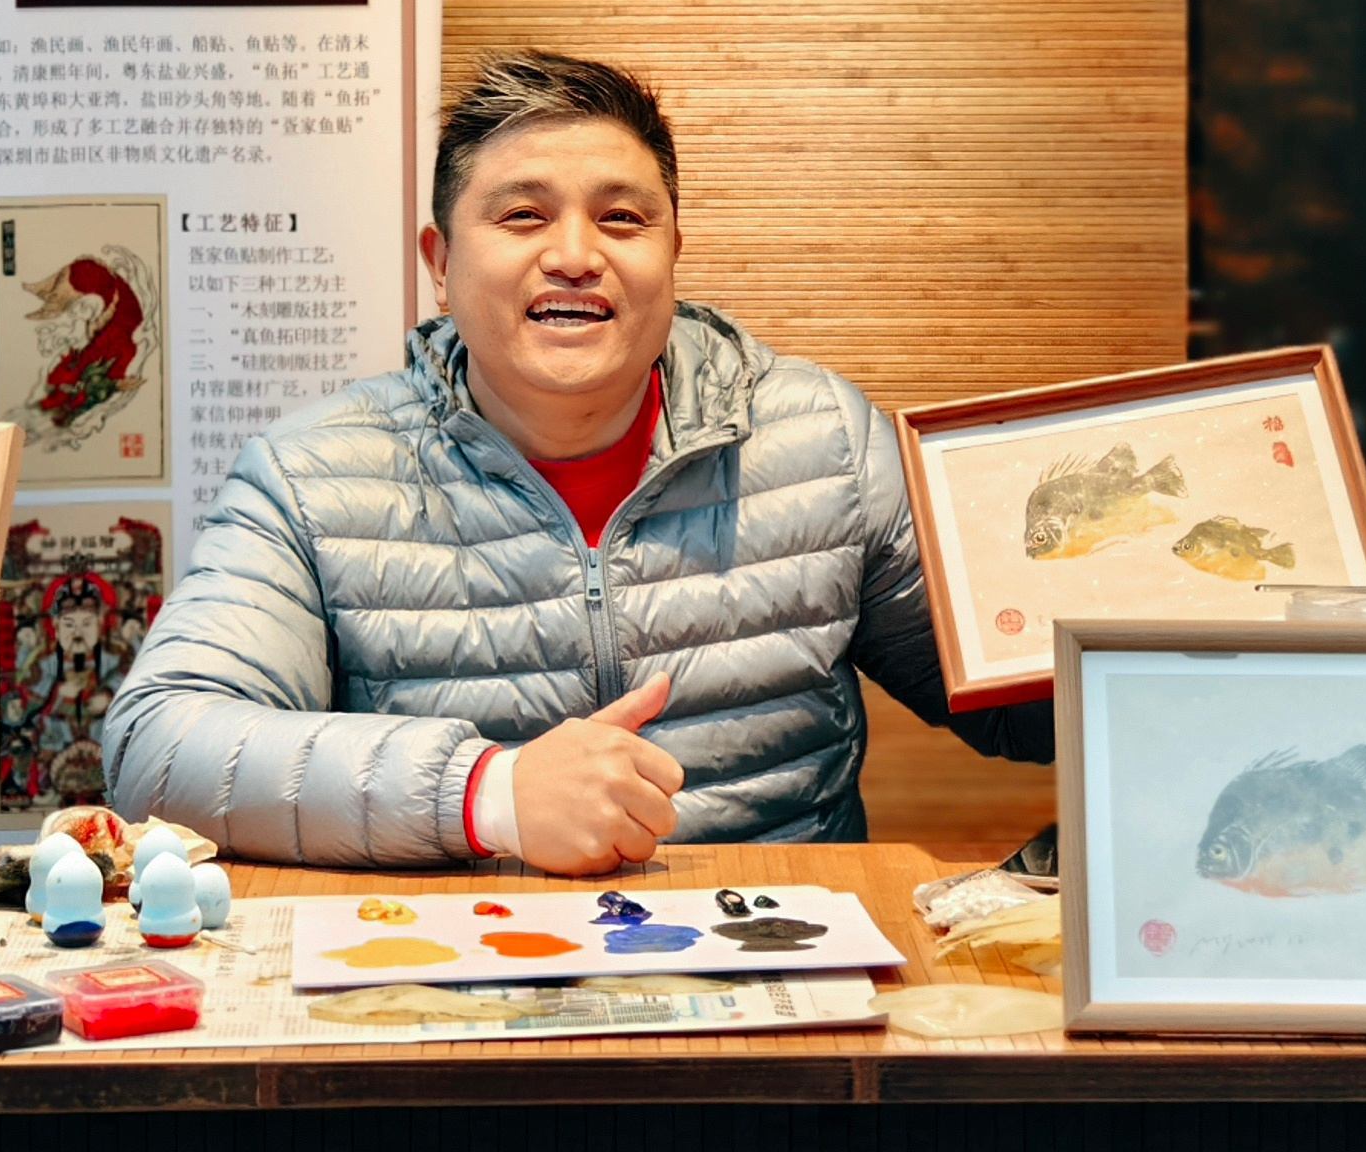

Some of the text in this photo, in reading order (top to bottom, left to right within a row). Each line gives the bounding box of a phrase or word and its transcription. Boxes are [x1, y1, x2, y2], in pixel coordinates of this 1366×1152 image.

[181, 213, 297, 233] 【工艺特征】
[188, 274, 347, 293] 以如下三种工艺为主
